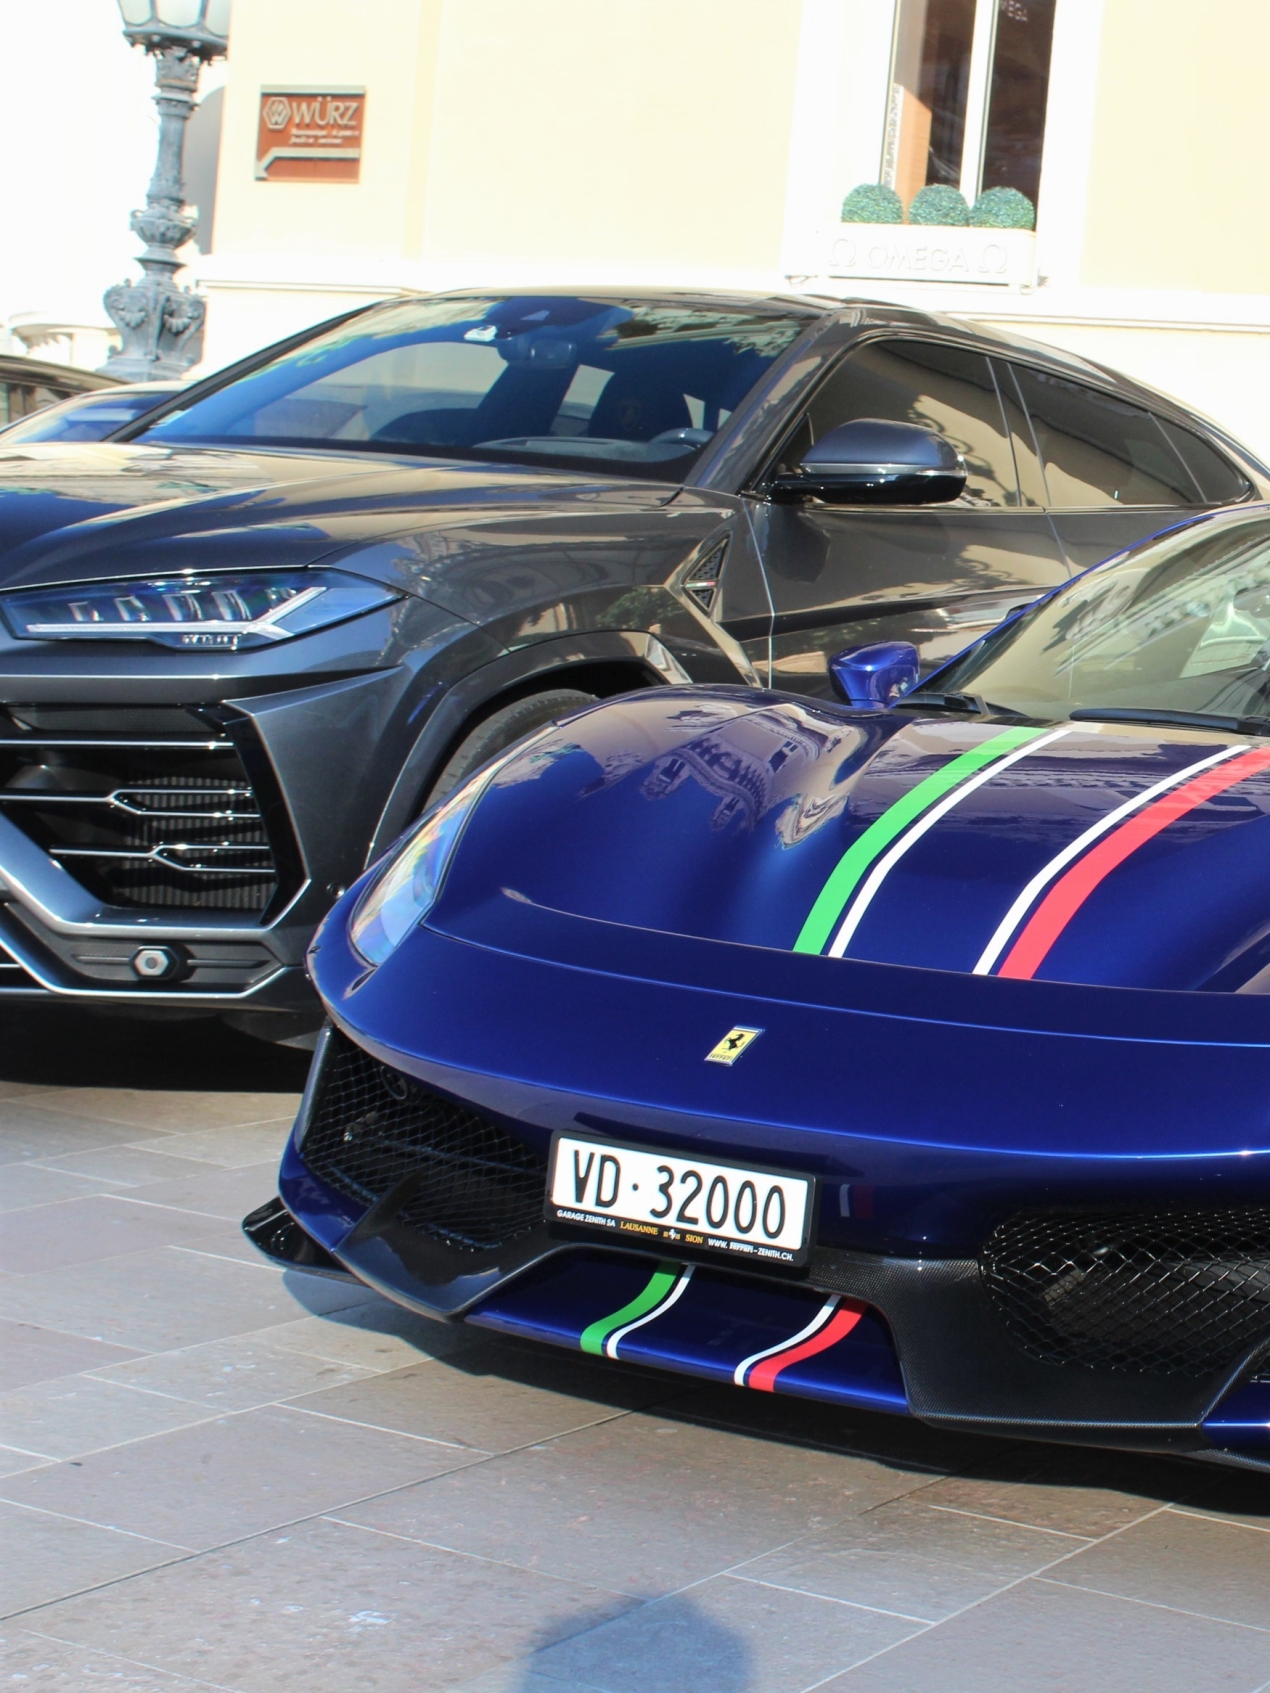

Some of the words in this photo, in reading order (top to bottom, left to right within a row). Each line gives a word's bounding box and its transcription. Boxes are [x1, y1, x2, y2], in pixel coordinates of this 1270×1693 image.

[291, 96, 359, 126] WÜRZ
[868, 244, 970, 273] OMEGA
[557, 1209, 585, 1222] GARAGE
[584, 1215, 606, 1226] ZENITH
[606, 1219, 616, 1227] SA
[620, 1221, 659, 1235] LAUSANNE
[685, 1234, 704, 1244] SION
